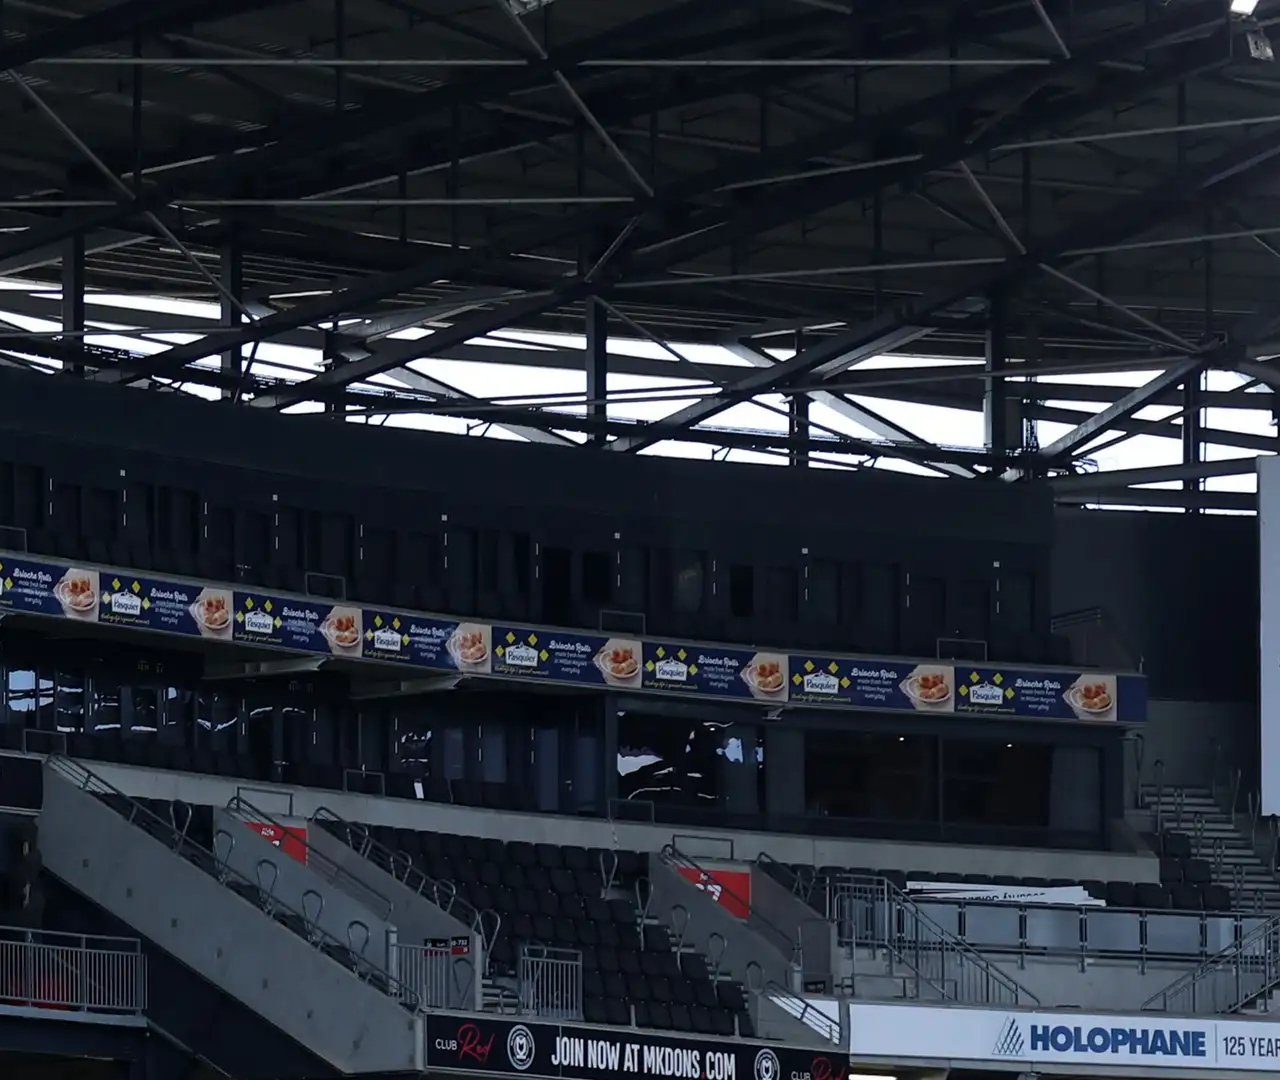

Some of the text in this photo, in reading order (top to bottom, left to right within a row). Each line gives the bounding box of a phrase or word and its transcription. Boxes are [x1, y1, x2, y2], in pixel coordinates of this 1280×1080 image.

[114, 601, 139, 611] Pasquier
[247, 617, 271, 630] Pasquier
[549, 640, 591, 653] Brioche Rolls
[508, 651, 535, 663] Pasquier
[659, 666, 684, 676] Pasquier
[851, 667, 897, 679] Brioche Rolls
[806, 678, 835, 691] Pasquier
[1015, 678, 1061, 690] Brioche Rolls
[973, 689, 1000, 701] Pasquier
[435, 1038, 458, 1050] CLUB
[458, 1024, 495, 1063] Red
[1030, 1024, 1206, 1058] HOLOPHANE
[1223, 1036, 1246, 1056] 125
[551, 1036, 584, 1068] JOIN
[588, 1039, 620, 1070] NOW
[623, 1043, 640, 1073] AT
